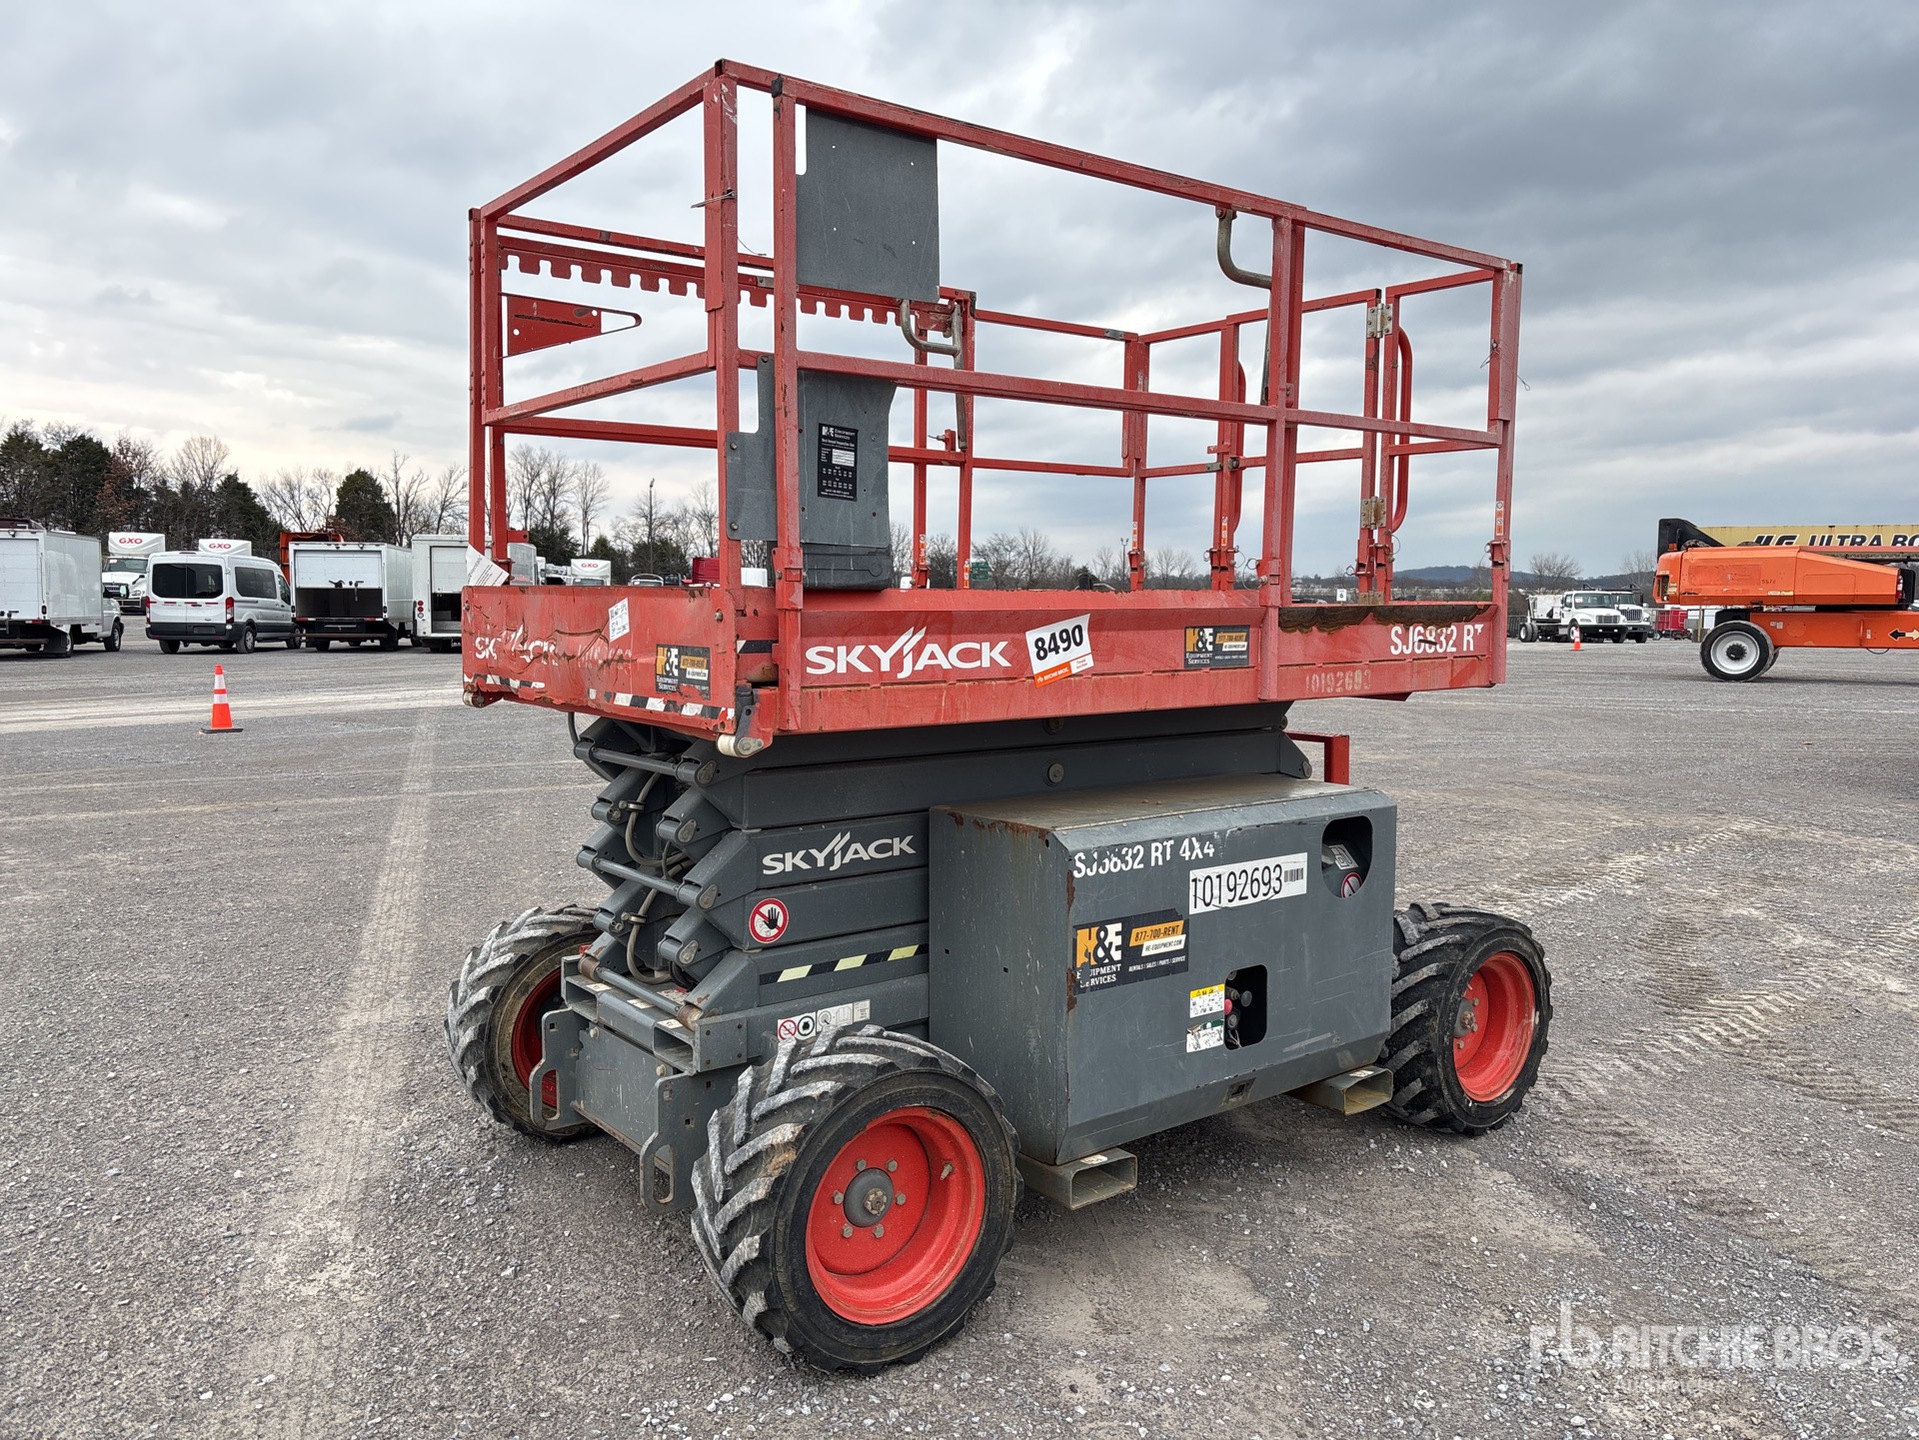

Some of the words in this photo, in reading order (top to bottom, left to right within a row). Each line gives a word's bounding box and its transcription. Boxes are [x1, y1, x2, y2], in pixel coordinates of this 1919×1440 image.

[119, 537, 143, 545] GXO
[805, 626, 1012, 679] SKYJACK
[1034, 624, 1084, 661] 8490
[1186, 628, 1213, 651] H&E
[1390, 625, 1457, 655] SJ6832
[762, 831, 916, 875] SKYJACK
[1191, 864, 1283, 909] 10192693
[1077, 923, 1122, 967] H&E
[1134, 925, 1180, 942] 877-700-RENT
[1076, 964, 1122, 980] EUIPMENT
